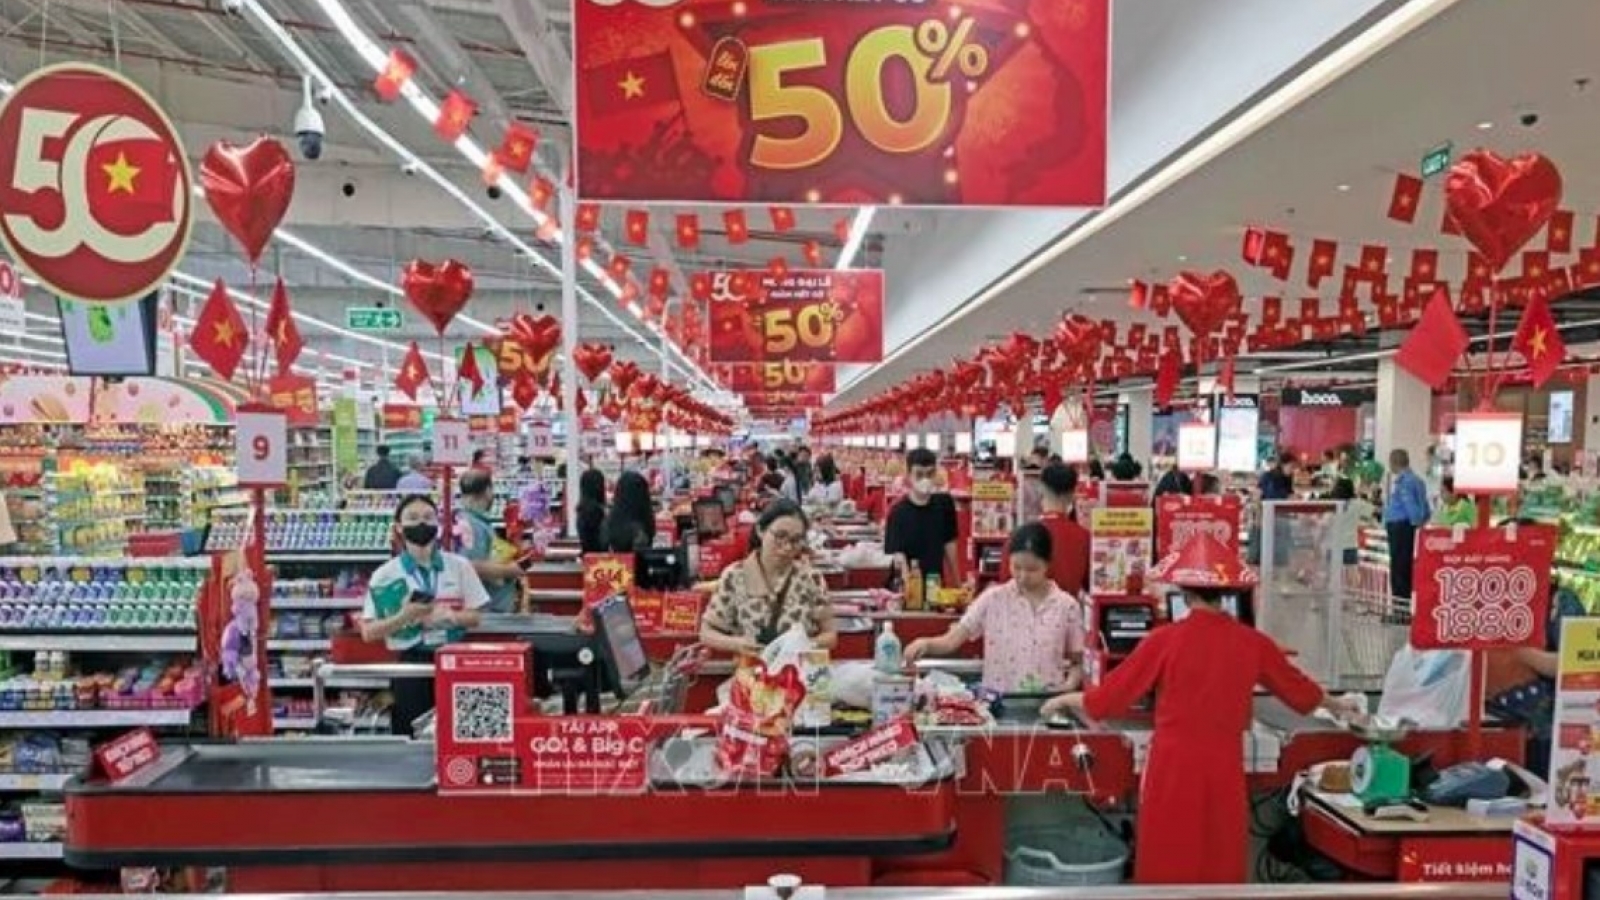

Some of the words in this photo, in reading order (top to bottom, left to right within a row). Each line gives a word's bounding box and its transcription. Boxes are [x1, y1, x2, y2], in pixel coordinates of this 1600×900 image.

[748, 16, 989, 170] 50%
[4, 106, 185, 262] 50
[764, 301, 845, 353] 50%
[252, 433, 271, 461] 9
[442, 434, 459, 450] 11
[1465, 441, 1506, 468] 10
[1434, 567, 1536, 604] 1900
[1432, 604, 1535, 642] 1880
[530, 735, 569, 753] GO!
[572, 736, 588, 753] &
[591, 733, 625, 755] Big
[628, 736, 644, 753] C
